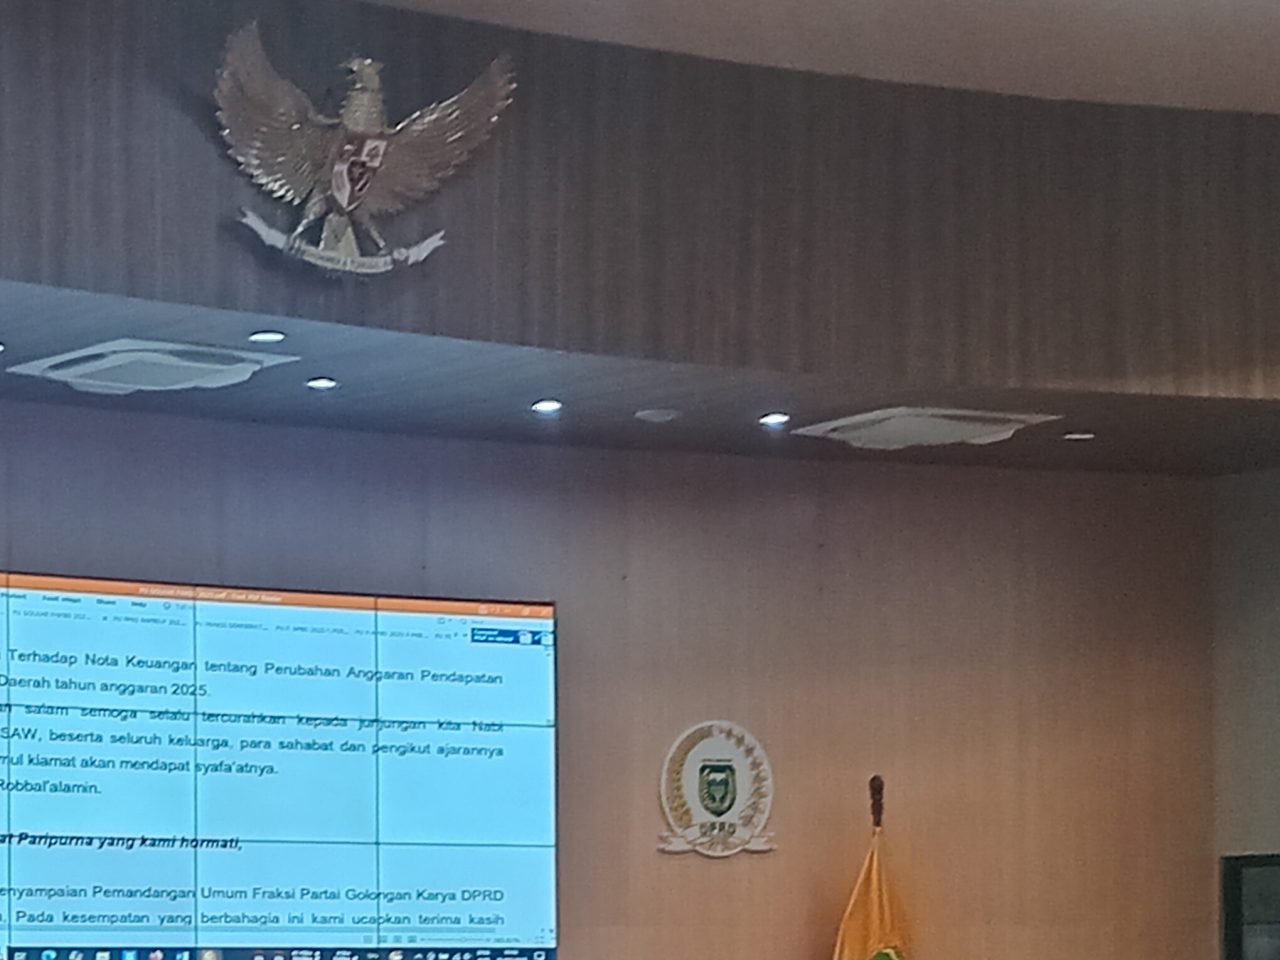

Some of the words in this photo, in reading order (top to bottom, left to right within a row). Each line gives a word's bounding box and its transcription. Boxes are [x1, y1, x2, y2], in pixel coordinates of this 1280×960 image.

[9, 649, 78, 666] Terhadap
[85, 653, 118, 668] Nota
[125, 655, 196, 672] Keuangan
[205, 661, 257, 676] tentang
[265, 662, 340, 678] Perubahan
[347, 666, 414, 682] Anggaran
[421, 669, 503, 685] Pendapatan
[55, 677, 95, 691] tahun
[100, 682, 167, 696] anggaran
[25, 703, 69, 716] salam
[80, 708, 137, 721] semoga
[149, 708, 190, 722] selalu
[202, 711, 286, 726] tercurahkan
[296, 714, 348, 730] kepada
[358, 717, 426, 733] junjungan
[437, 719, 462, 732] kita
[472, 720, 504, 733] Nabi
[49, 729, 103, 744] beserta
[110, 731, 162, 746] seluruh
[240, 739, 271, 752] para
[278, 738, 334, 752] sahabat
[340, 740, 366, 753] dan
[372, 742, 431, 757] pengikut
[436, 743, 504, 759] ajarannya
[27, 753, 76, 768] kiamat
[80, 756, 115, 769] akan
[120, 757, 190, 773] mendapat
[17, 832, 93, 848] Paripurna
[97, 836, 135, 850] yang
[140, 836, 176, 849] kami
[179, 836, 242, 851] hormati,
[92, 886, 196, 901] Pemandangan
[201, 887, 247, 900] Umum
[253, 887, 295, 900] Fraksi
[300, 887, 340, 900] Partai
[345, 888, 411, 903] Golongan
[416, 889, 457, 904] Karya
[461, 889, 504, 901] DPRD
[16, 911, 53, 923] Pada
[62, 911, 150, 925] kesempatan
[157, 913, 192, 926] yang
[201, 911, 280, 926] berbahagia
[288, 912, 303, 924] ini
[311, 912, 345, 925] kami
[351, 913, 411, 927] ucapkan
[419, 913, 461, 925] terima
[469, 914, 504, 925] kasih
